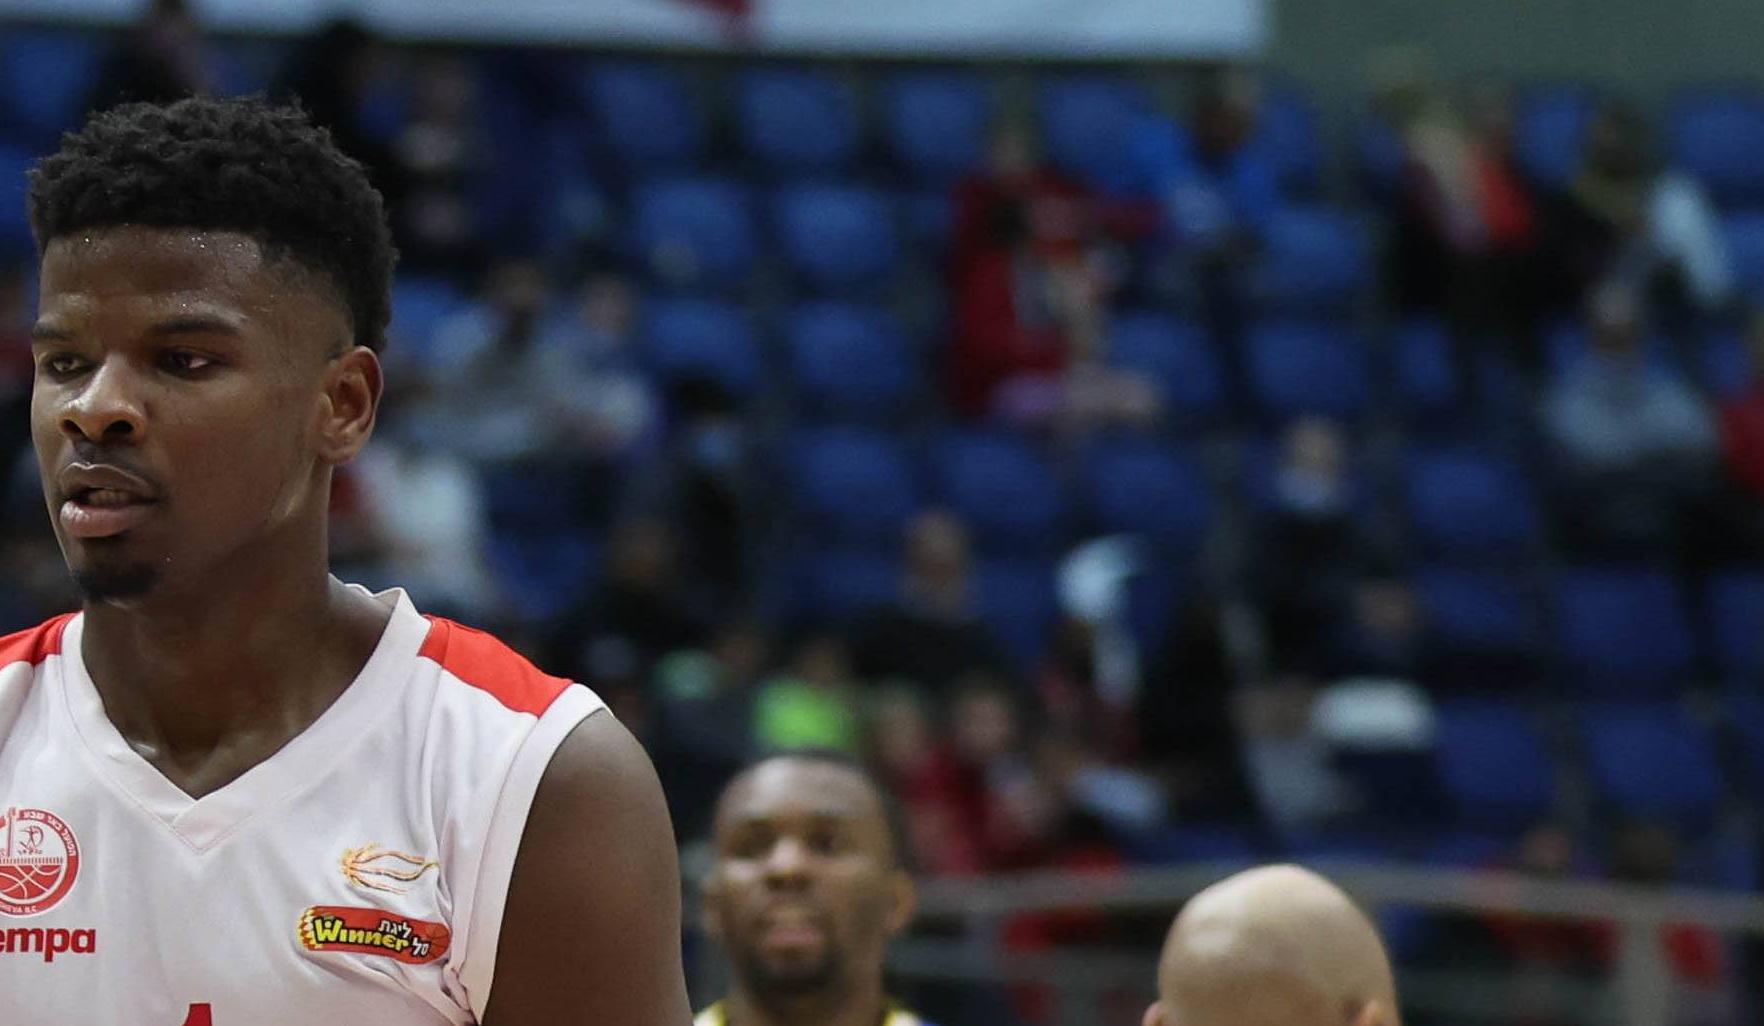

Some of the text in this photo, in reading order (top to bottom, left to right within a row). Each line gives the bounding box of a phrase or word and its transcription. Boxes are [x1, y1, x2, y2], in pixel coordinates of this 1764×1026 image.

[313, 917, 410, 953] Winner
[378, 919, 412, 940] ליגת
[411, 936, 431, 957] סל
